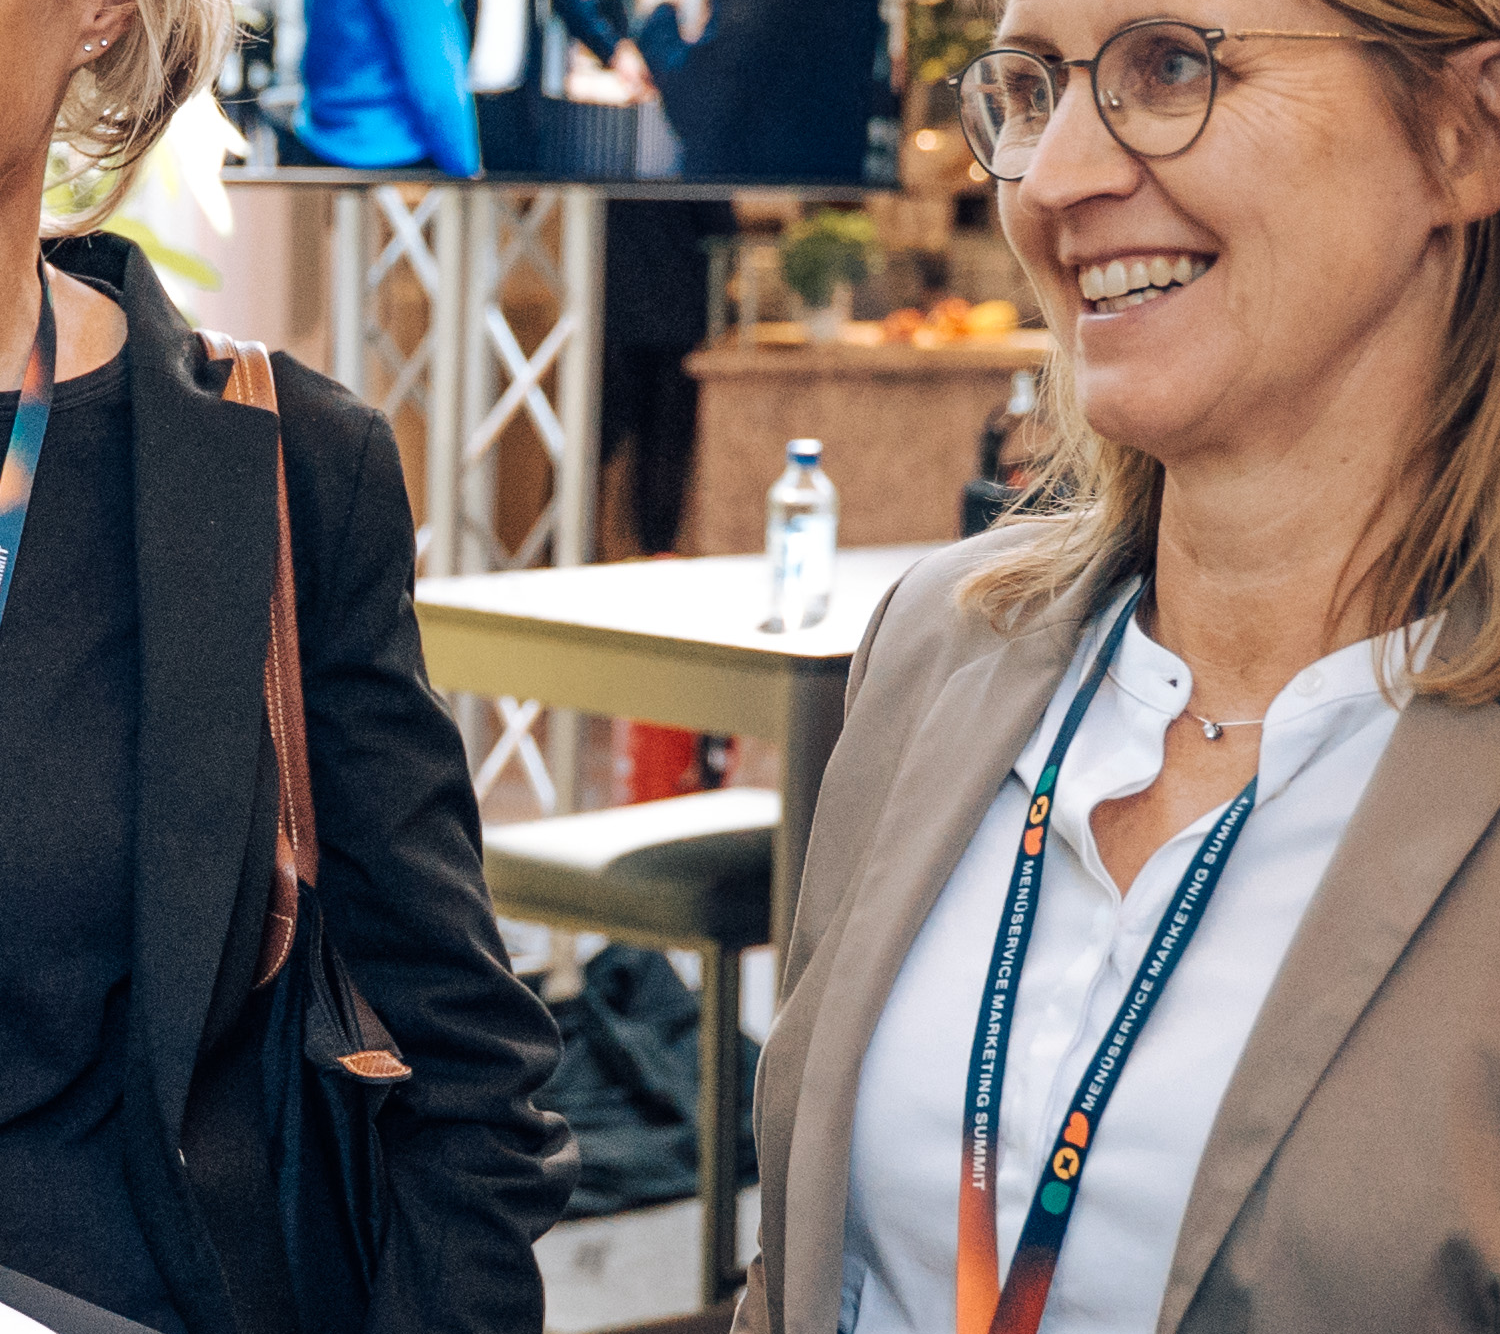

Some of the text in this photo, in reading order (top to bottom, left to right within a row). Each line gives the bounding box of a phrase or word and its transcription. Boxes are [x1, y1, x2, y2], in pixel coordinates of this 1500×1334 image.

[972, 860, 1035, 1191] MENÜSERVICE MARKETING SUMMIT
[1080, 797, 1250, 1112] MENÜSERVICE MARKETING SUMMIT
